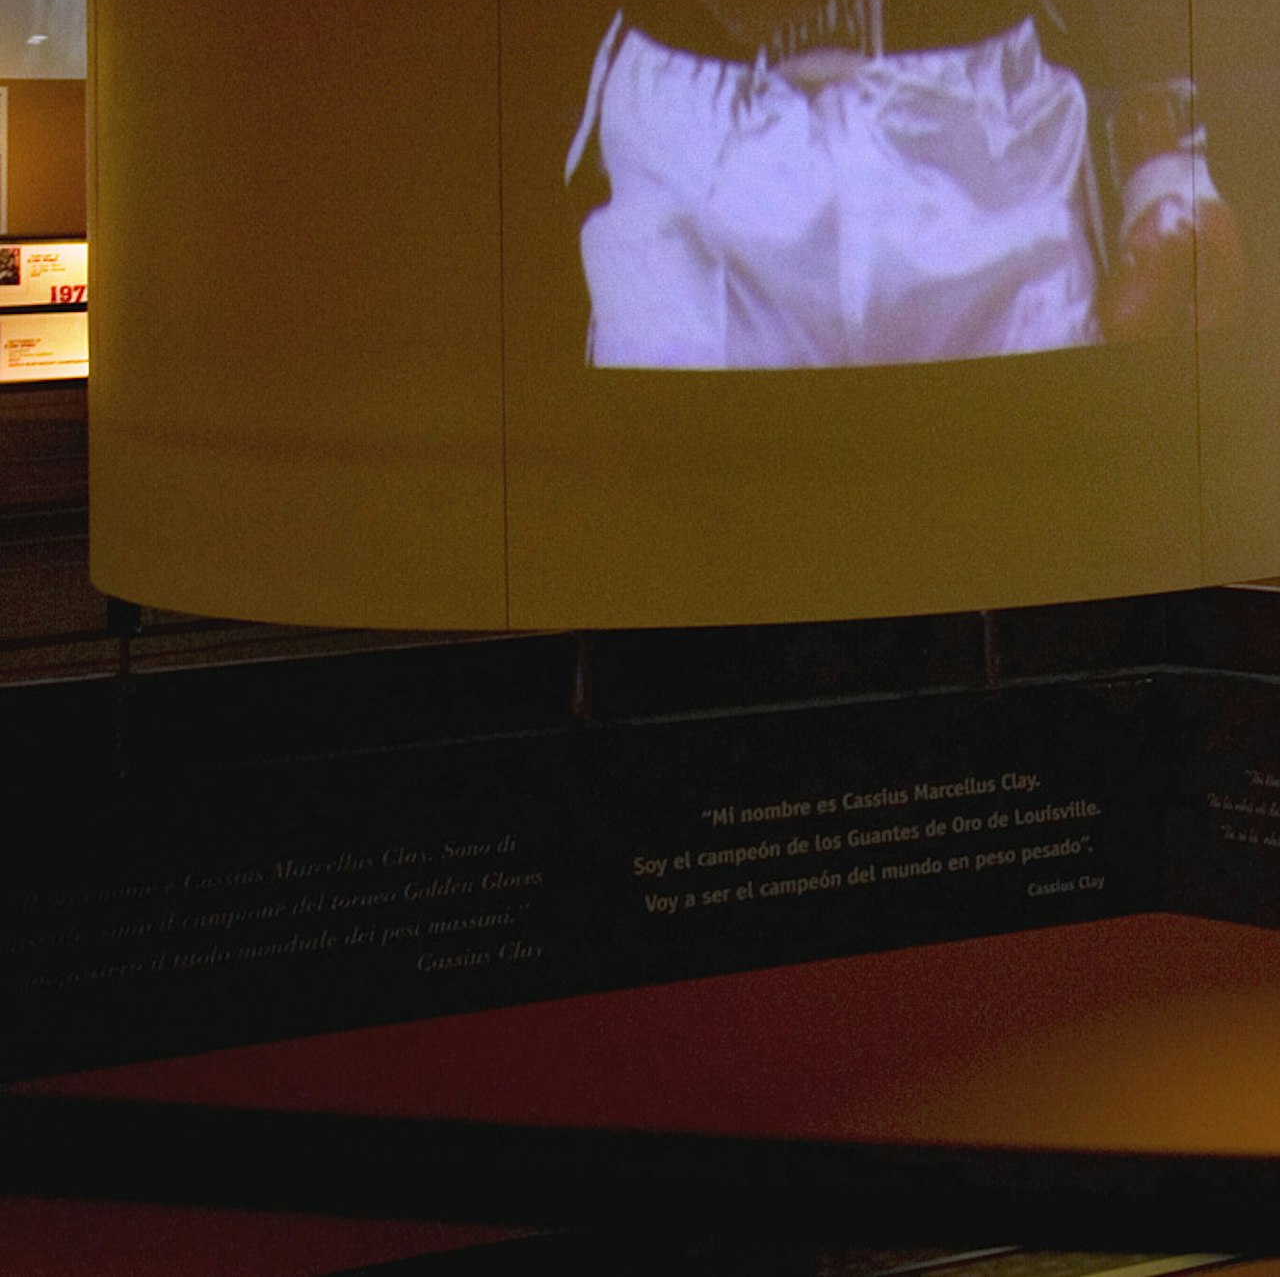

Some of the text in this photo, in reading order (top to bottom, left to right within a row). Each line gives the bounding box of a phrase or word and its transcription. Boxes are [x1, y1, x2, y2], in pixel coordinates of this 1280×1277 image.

[741, 798, 811, 823] nombre
[816, 798, 837, 814] es
[842, 788, 909, 811] Cassius
[913, 777, 997, 803] Marcellus
[1000, 772, 1042, 795] Clay.
[270, 850, 374, 882] Marcellus
[441, 837, 492, 862] Sono
[495, 833, 517, 855] di
[632, 799, 1103, 879] Soy el campeón de los Guantes de Oro de Louisville.
[292, 892, 324, 915] del
[330, 890, 397, 911] torneo
[403, 879, 473, 902] Golden
[480, 869, 545, 893] Gloves
[644, 891, 680, 915] Voy
[685, 894, 697, 908] a
[701, 888, 731, 906] ser
[735, 882, 752, 901] el
[758, 870, 842, 900] campeón
[847, 865, 876, 886] del
[880, 856, 943, 880] mundo
[947, 854, 971, 872] en
[974, 849, 1017, 872] peso
[1026, 872, 1106, 899] Cassius Clay
[344, 924, 377, 947] dei
[380, 919, 424, 946] pesi
[415, 940, 545, 973] Cassius Clay
